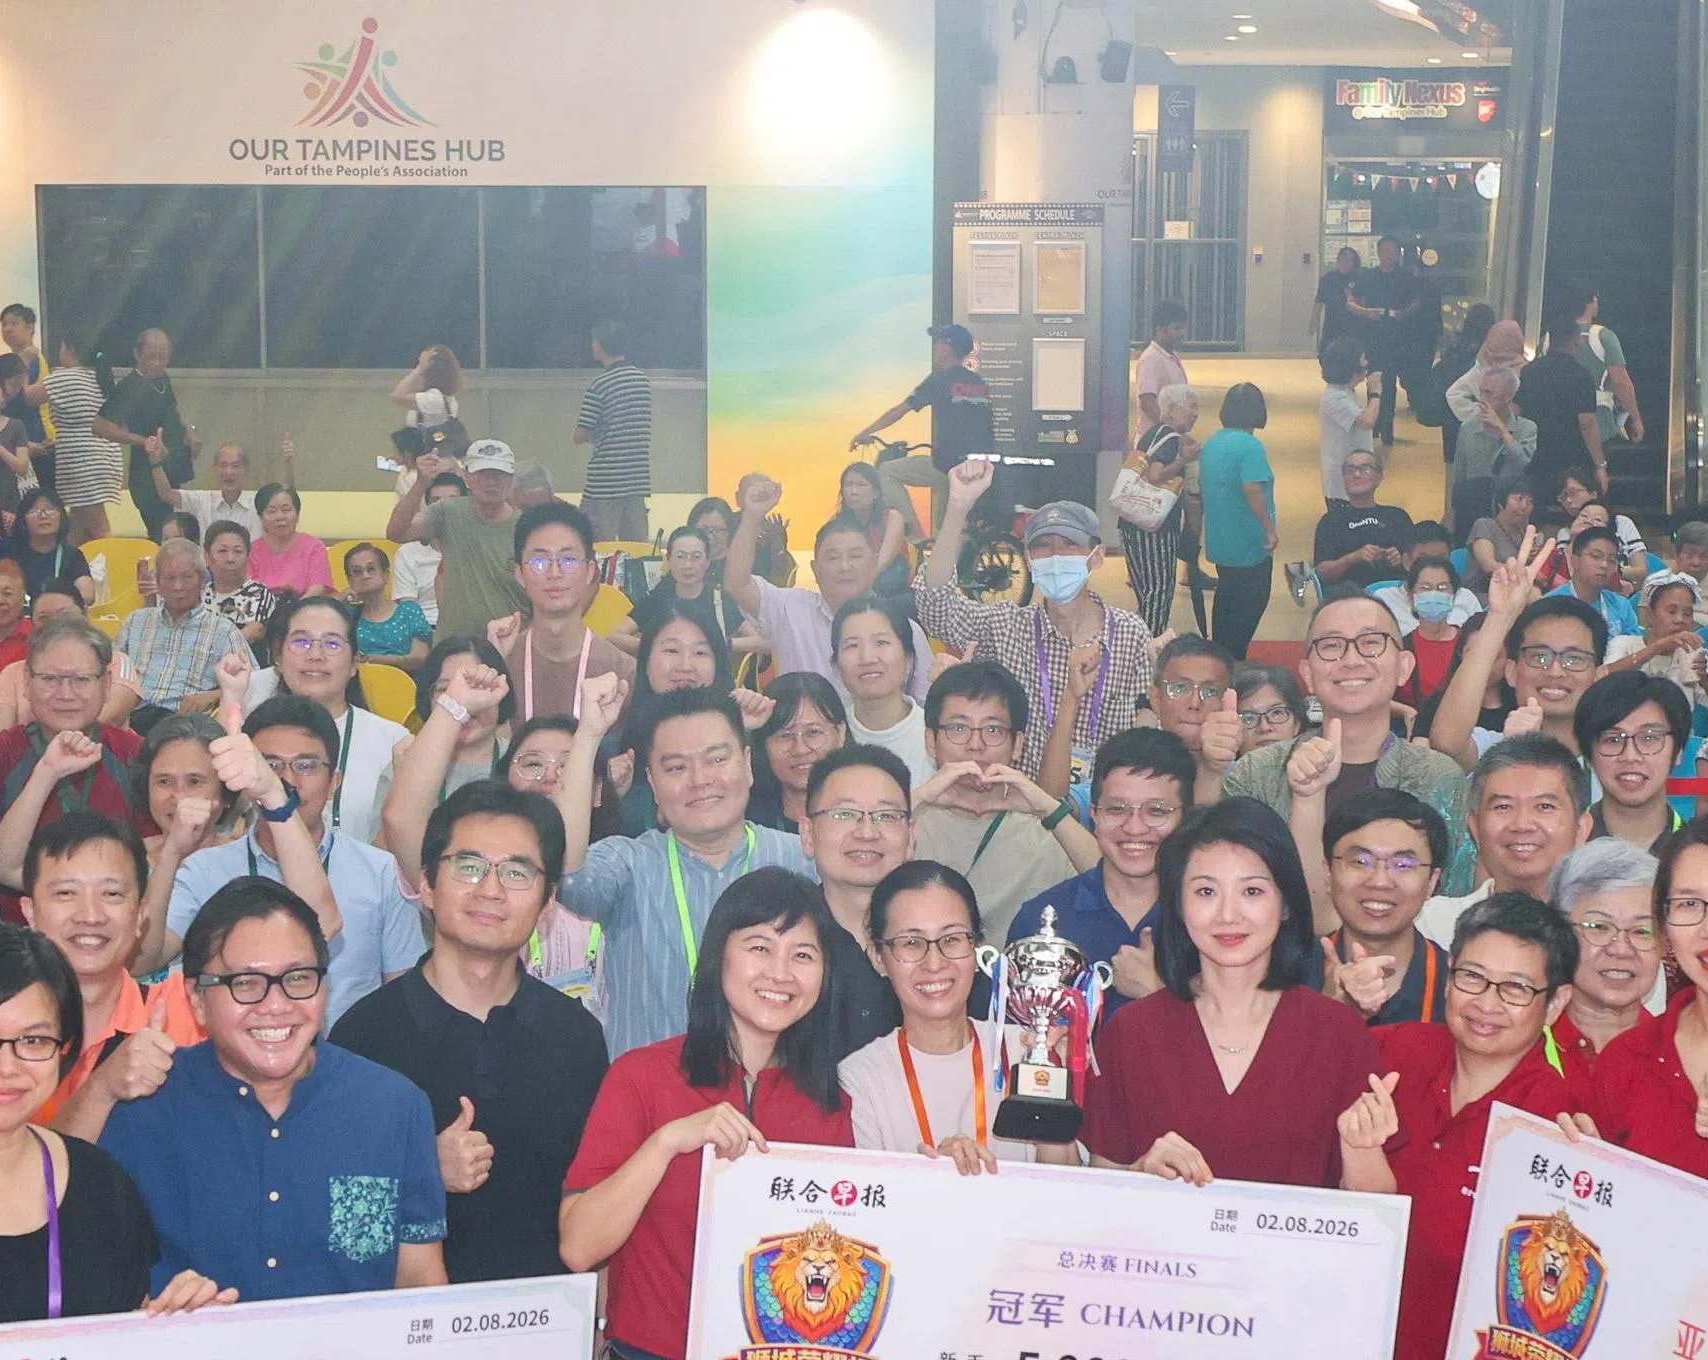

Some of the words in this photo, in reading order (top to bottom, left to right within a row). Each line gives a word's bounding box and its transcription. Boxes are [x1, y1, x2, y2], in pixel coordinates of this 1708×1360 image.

[1337, 77, 1401, 107] Family
[1402, 79, 1466, 106] Nexus
[229, 139, 289, 162] OUR
[296, 139, 436, 161] TAMPINES
[445, 140, 505, 162] HUB
[265, 164, 293, 177] Part
[295, 164, 309, 177] of
[314, 164, 333, 177] the
[336, 165, 389, 179] People's
[392, 165, 468, 177] Association
[979, 209, 1031, 221] PROGRAMME
[1034, 209, 1075, 221] SCHEDULE
[769, 1176, 886, 1208] 联合早报
[1529, 1154, 1613, 1208] 联合早报
[1214, 1208, 1238, 1222] 日期
[1256, 1213, 1359, 1237] 02.08.2026
[1210, 1221, 1237, 1234] Date
[1057, 1251, 1117, 1273] 总决赛
[1124, 1257, 1198, 1278] FINALS
[410, 1318, 433, 1332] 日期
[451, 1309, 549, 1334] 02.08.2026
[986, 1289, 1065, 1329] 冠军
[1080, 1302, 1255, 1338] CHAMPION
[407, 1332, 433, 1345] Date
